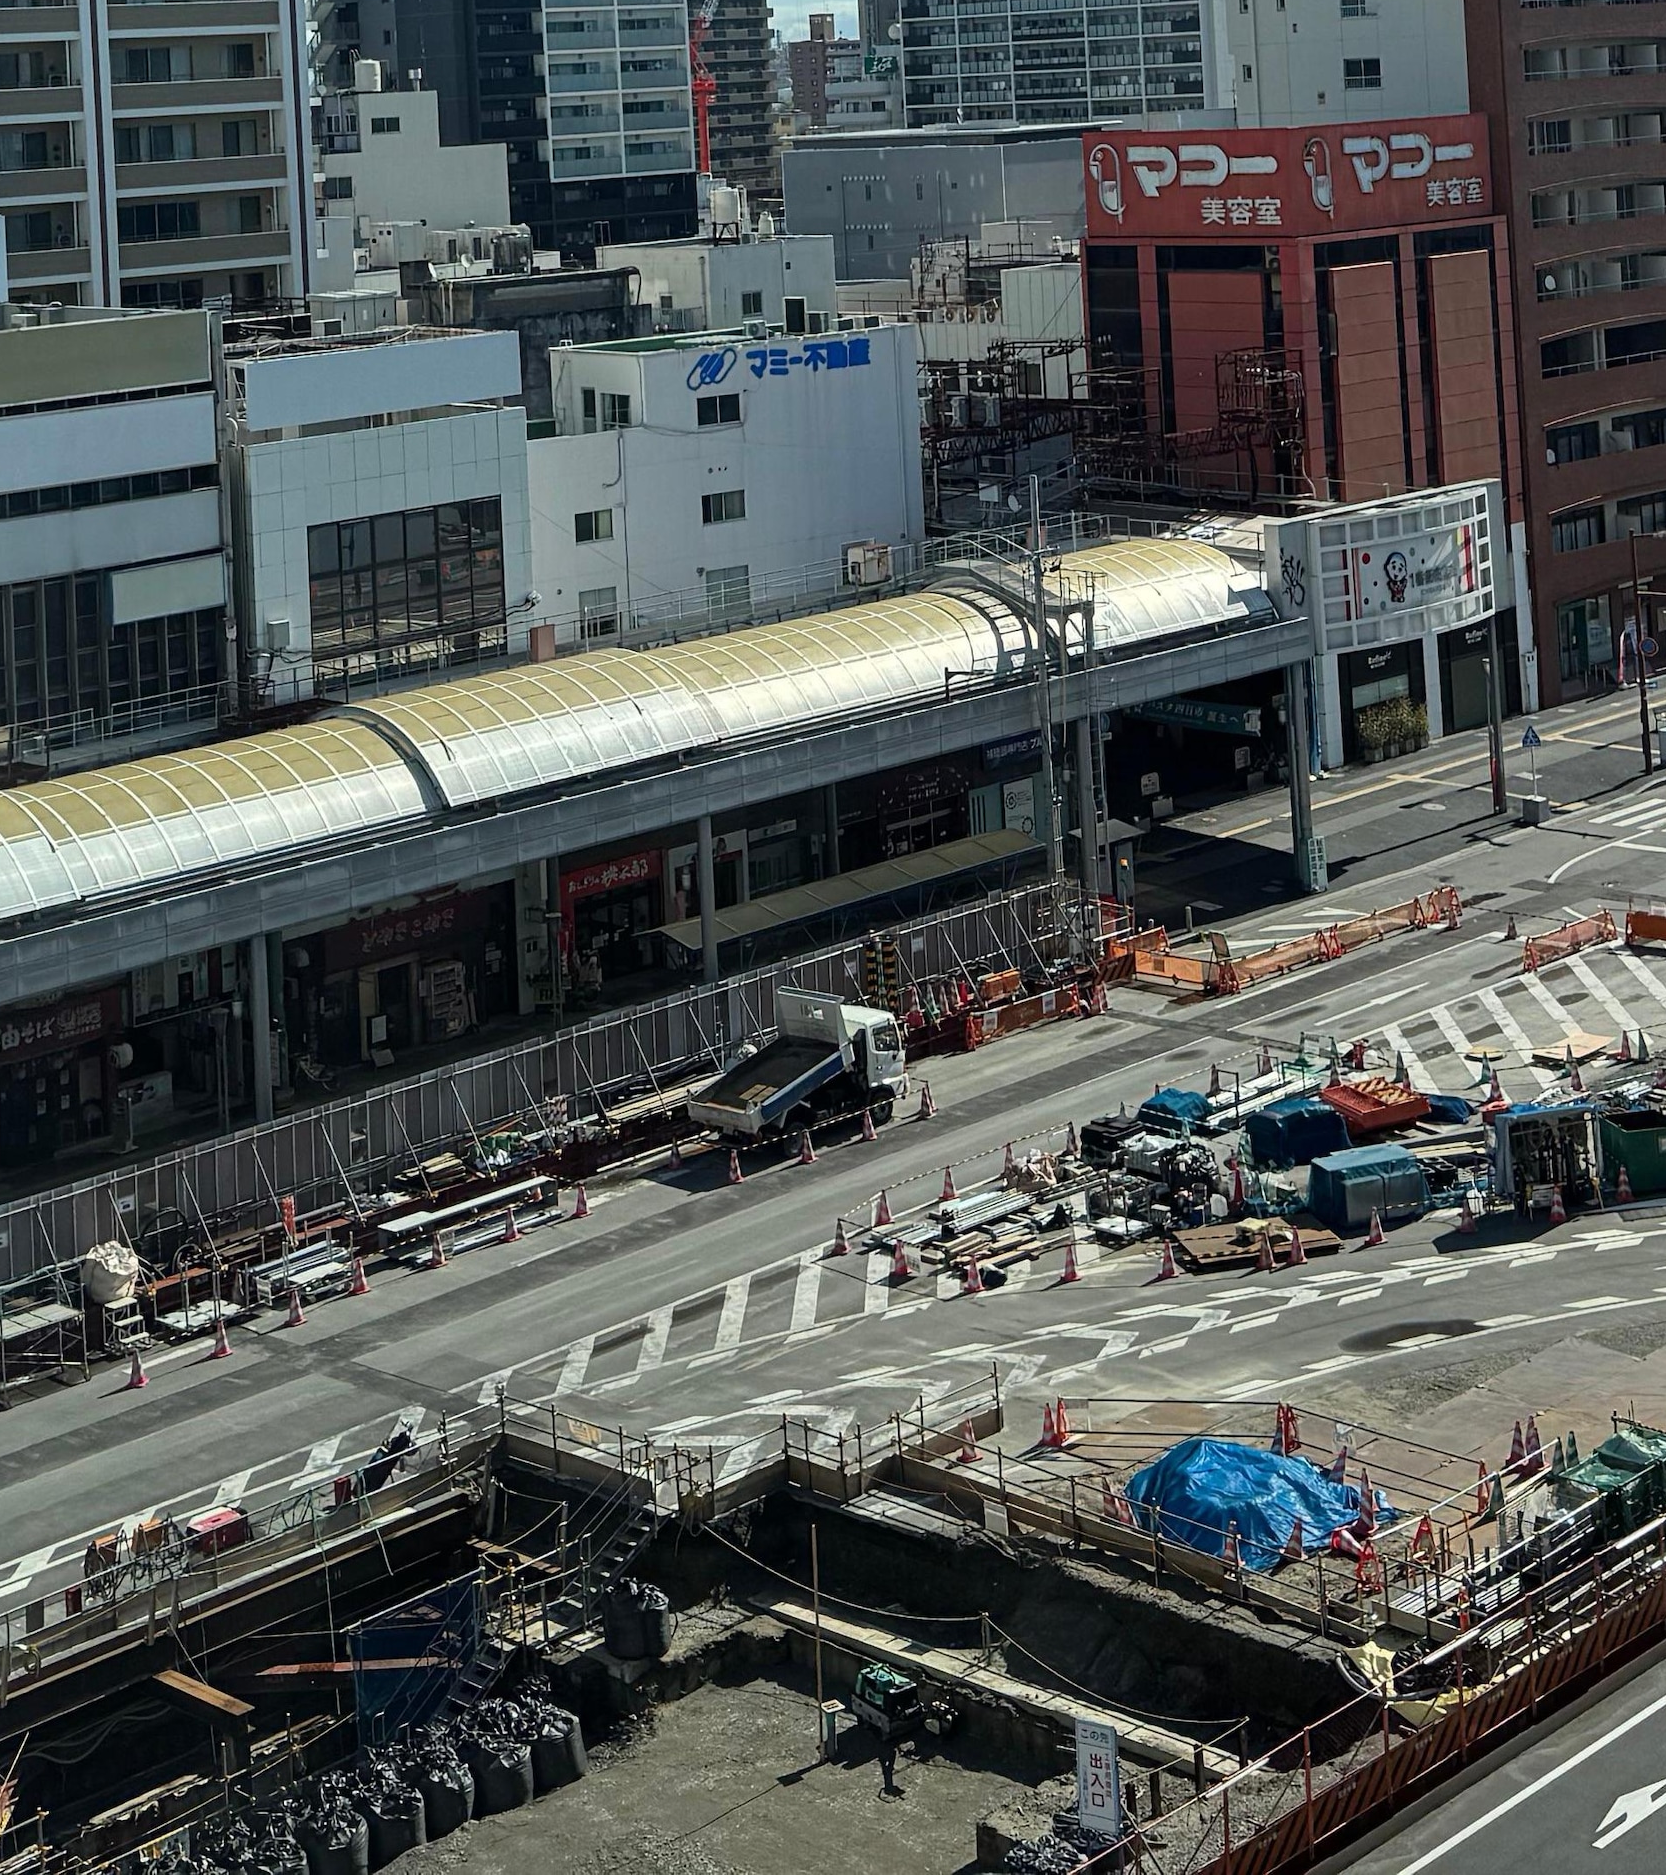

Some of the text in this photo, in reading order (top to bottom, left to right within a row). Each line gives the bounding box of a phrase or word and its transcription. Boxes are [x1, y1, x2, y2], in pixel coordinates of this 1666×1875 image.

[1126, 143, 1278, 197] マコー
[1342, 133, 1474, 194] マコー
[1200, 196, 1282, 226] 美容室
[1426, 176, 1484, 208] 美容室
[1090, 1753, 1105, 1808] 出入口
